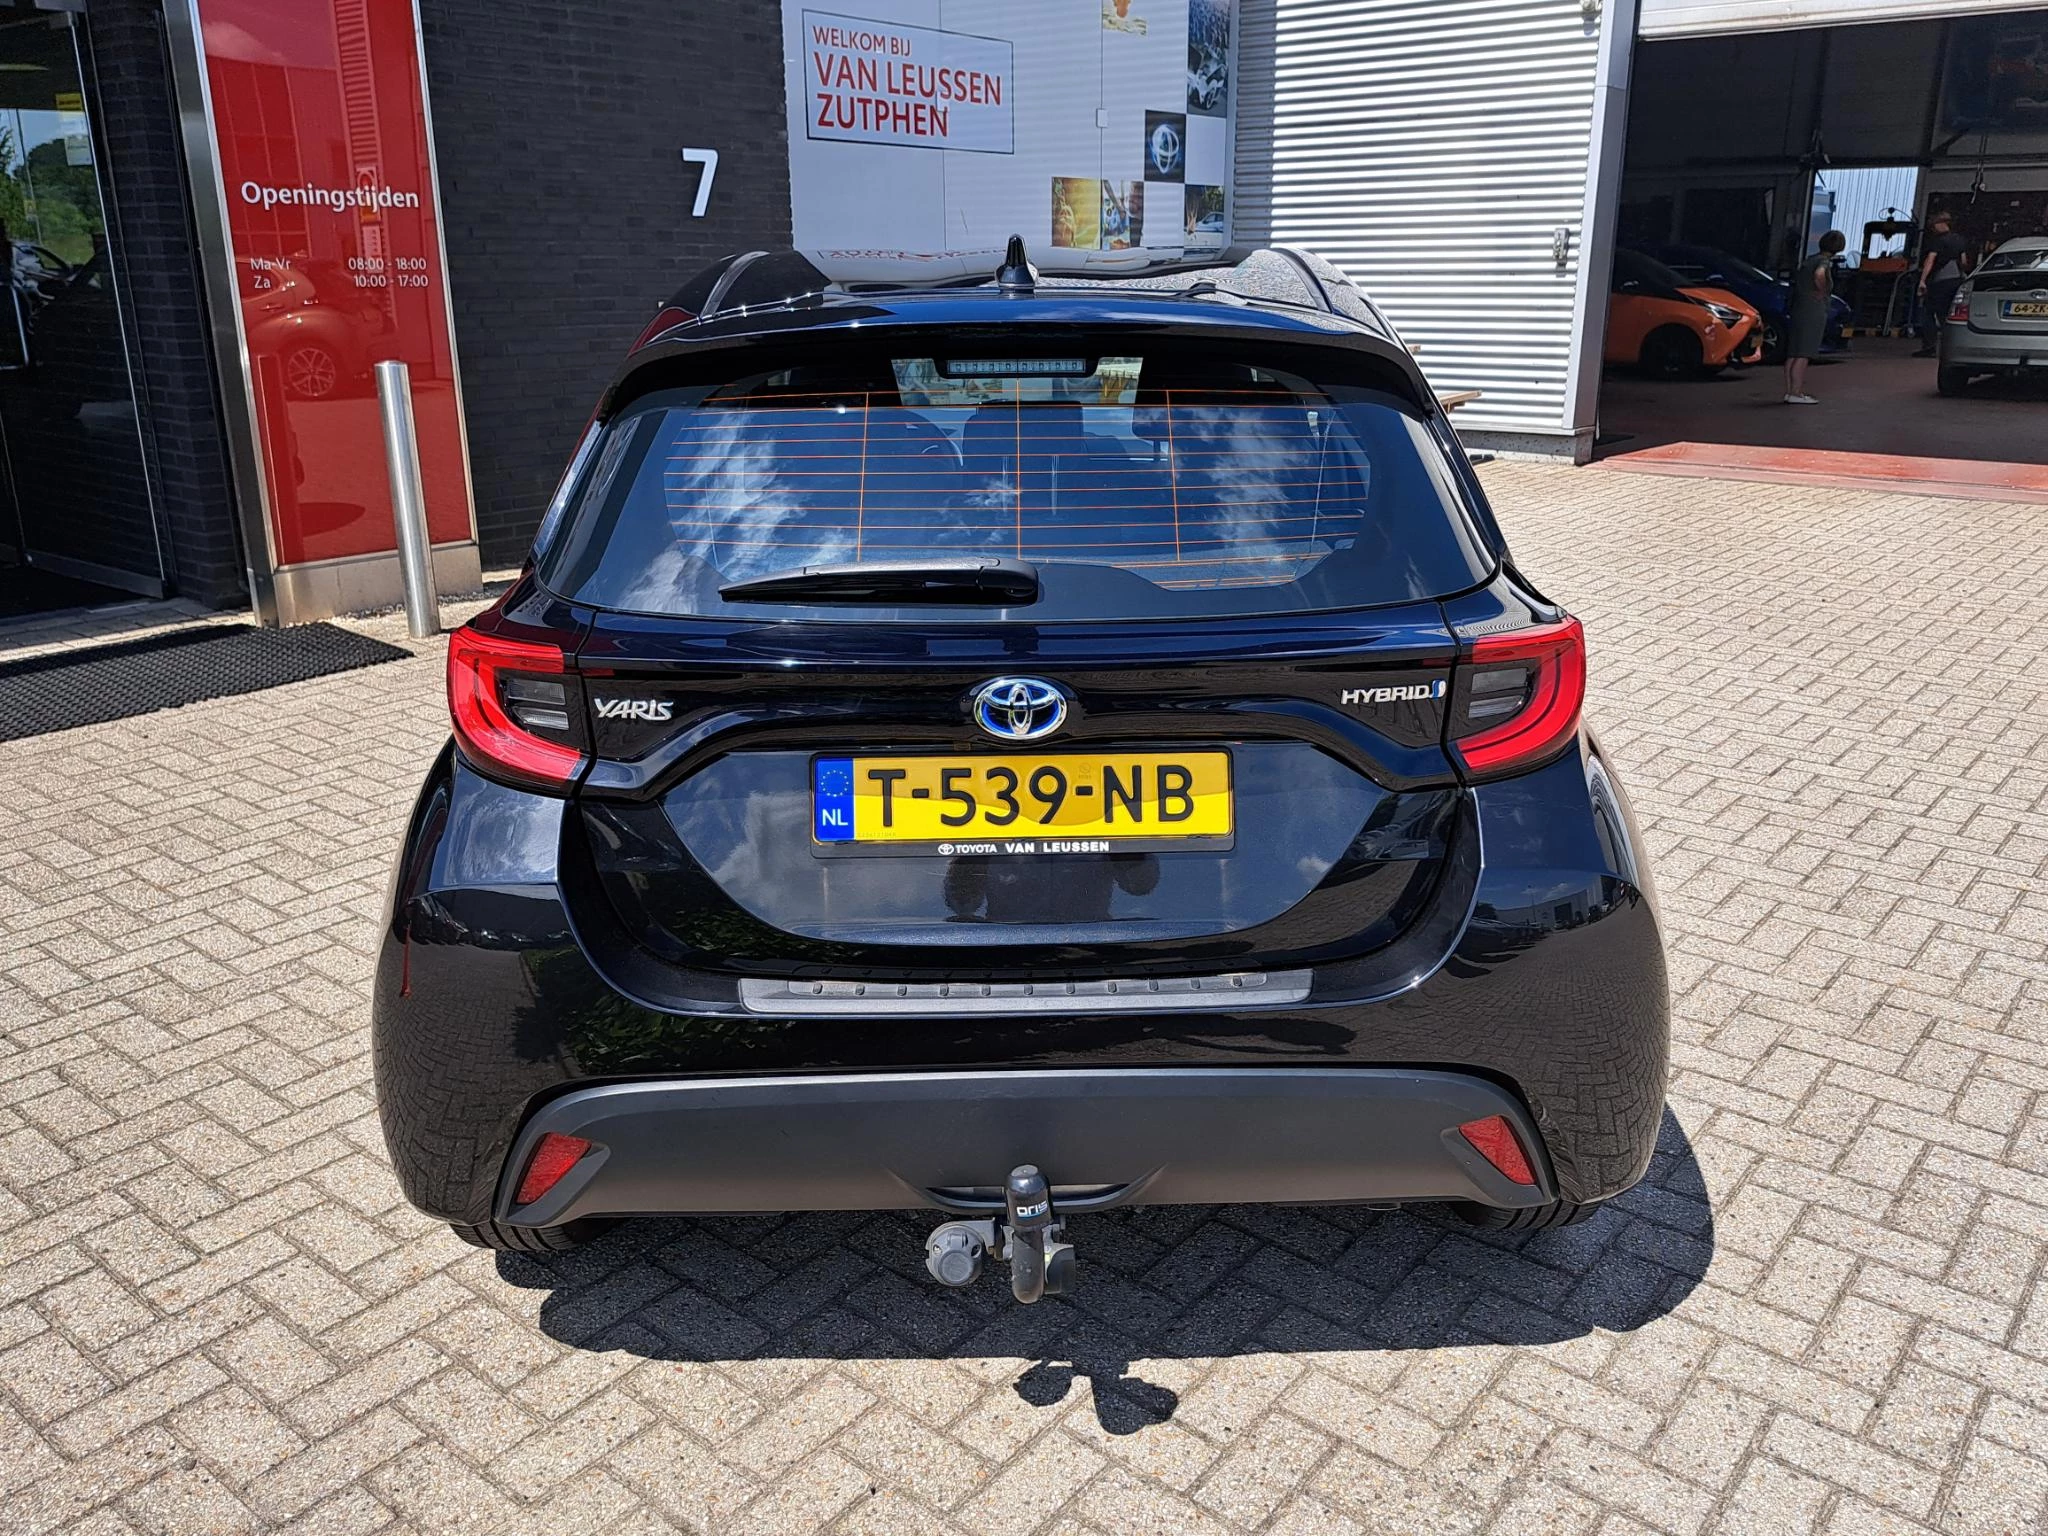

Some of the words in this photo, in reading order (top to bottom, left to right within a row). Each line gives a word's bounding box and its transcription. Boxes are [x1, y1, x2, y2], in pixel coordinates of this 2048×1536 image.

[812, 25, 886, 53] WELKOM
[890, 37, 911, 57] BIJ
[813, 51, 878, 92] VAN
[887, 61, 1001, 106] LEUSSEN
[816, 92, 948, 137] ZUTPHEN
[682, 148, 718, 217] 7
[240, 181, 420, 214] Openingstijden
[250, 257, 292, 271] Ma-Vr
[347, 257, 385, 271] 08:00
[394, 257, 428, 271] 18:00
[253, 275, 272, 289] Za
[353, 274, 387, 288] 10:00
[398, 275, 430, 288] 17:00
[1340, 684, 1430, 705] HYBRID
[593, 697, 674, 721] YARIS
[866, 763, 1195, 828] T-539-NB
[821, 808, 849, 827] NL
[955, 843, 998, 854] TOYOTA
[1004, 842, 1036, 854] VAN
[1042, 841, 1110, 853] LEUSSEN
